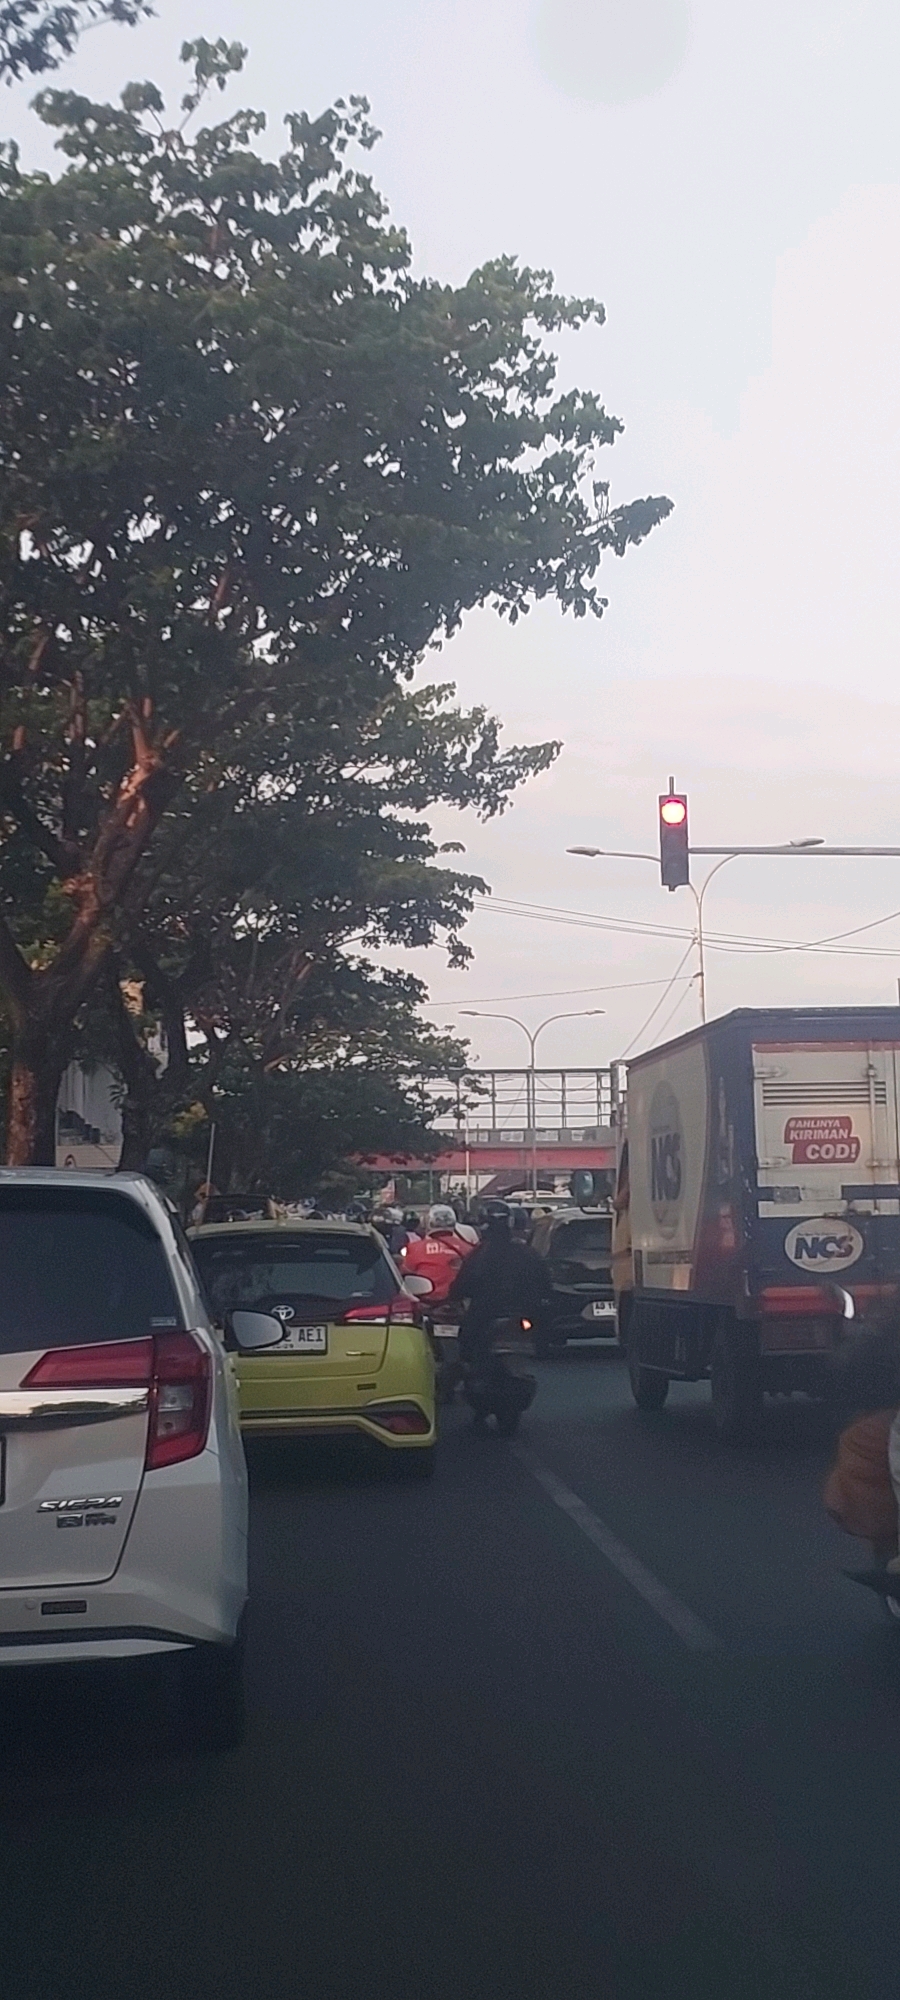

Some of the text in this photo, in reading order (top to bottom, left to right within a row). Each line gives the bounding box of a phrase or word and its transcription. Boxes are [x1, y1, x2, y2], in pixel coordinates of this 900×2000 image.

[789, 1119, 841, 1128] #AHLINYA
[789, 1129, 849, 1140] KIRIMAN
[805, 1143, 857, 1160] COD!
[651, 1132, 681, 1201] NCS
[794, 1235, 854, 1260] NCS
[298, 1328, 323, 1342] AEI
